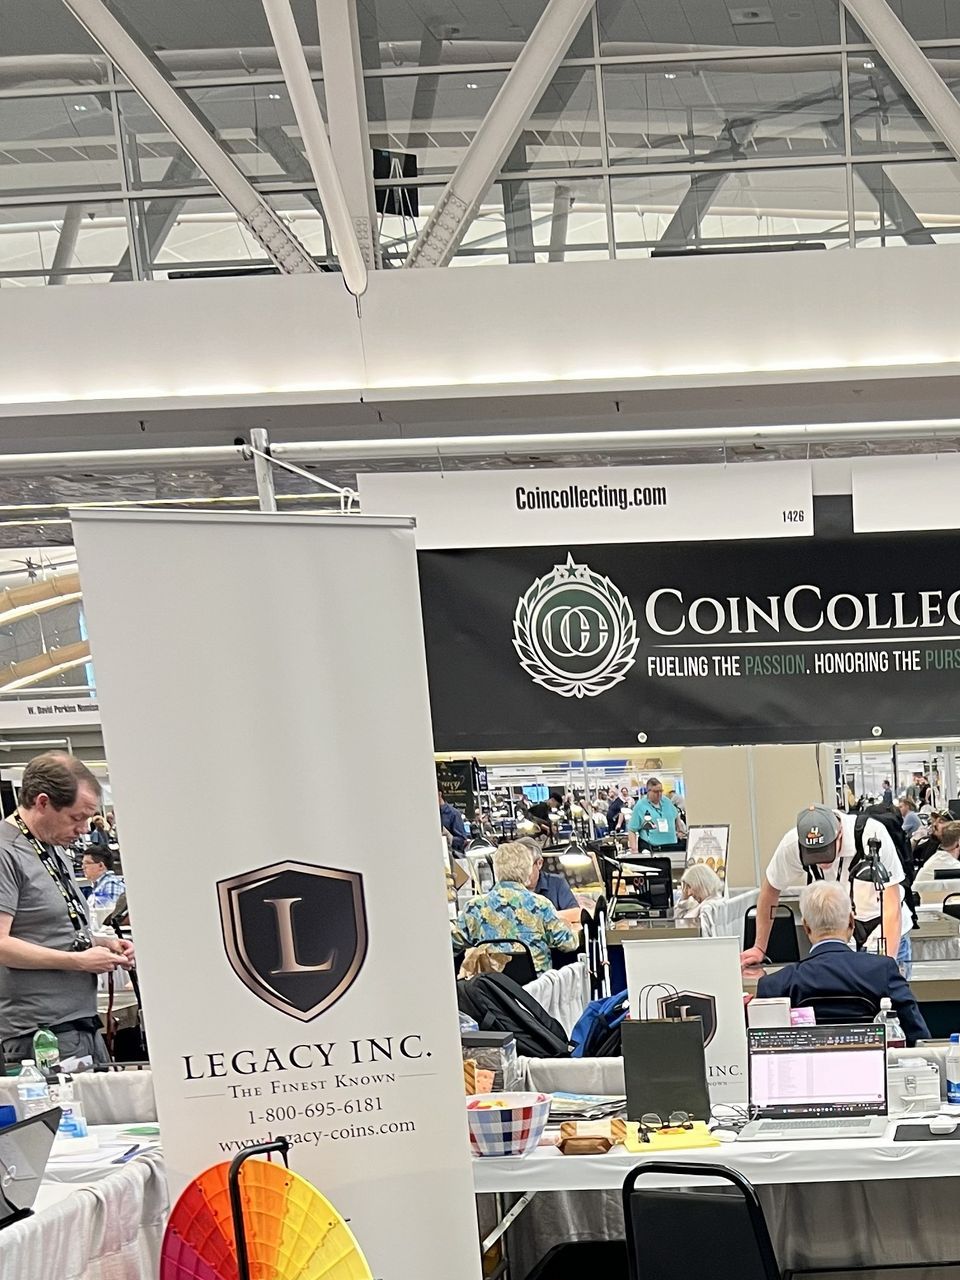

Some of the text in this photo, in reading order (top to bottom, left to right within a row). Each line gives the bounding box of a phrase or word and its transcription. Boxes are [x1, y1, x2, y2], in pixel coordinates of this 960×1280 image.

[515, 484, 666, 511] Coincollecting.com
[782, 510, 804, 523] 1426
[648, 655, 708, 677] FUELING
[713, 654, 740, 676] THE
[745, 653, 810, 676] PASSION.
[815, 649, 888, 675] HONORING
[893, 649, 921, 672] THE
[806, 836, 825, 845] LIFE
[811, 827, 819, 836] 4
[263, 897, 338, 976] L
[182, 1034, 432, 1081] LEGACY INC.
[709, 1064, 743, 1077] INC.
[248, 1096, 384, 1125] 1-800-695-6181
[219, 1119, 416, 1152] wwwlgacy-coins.com
